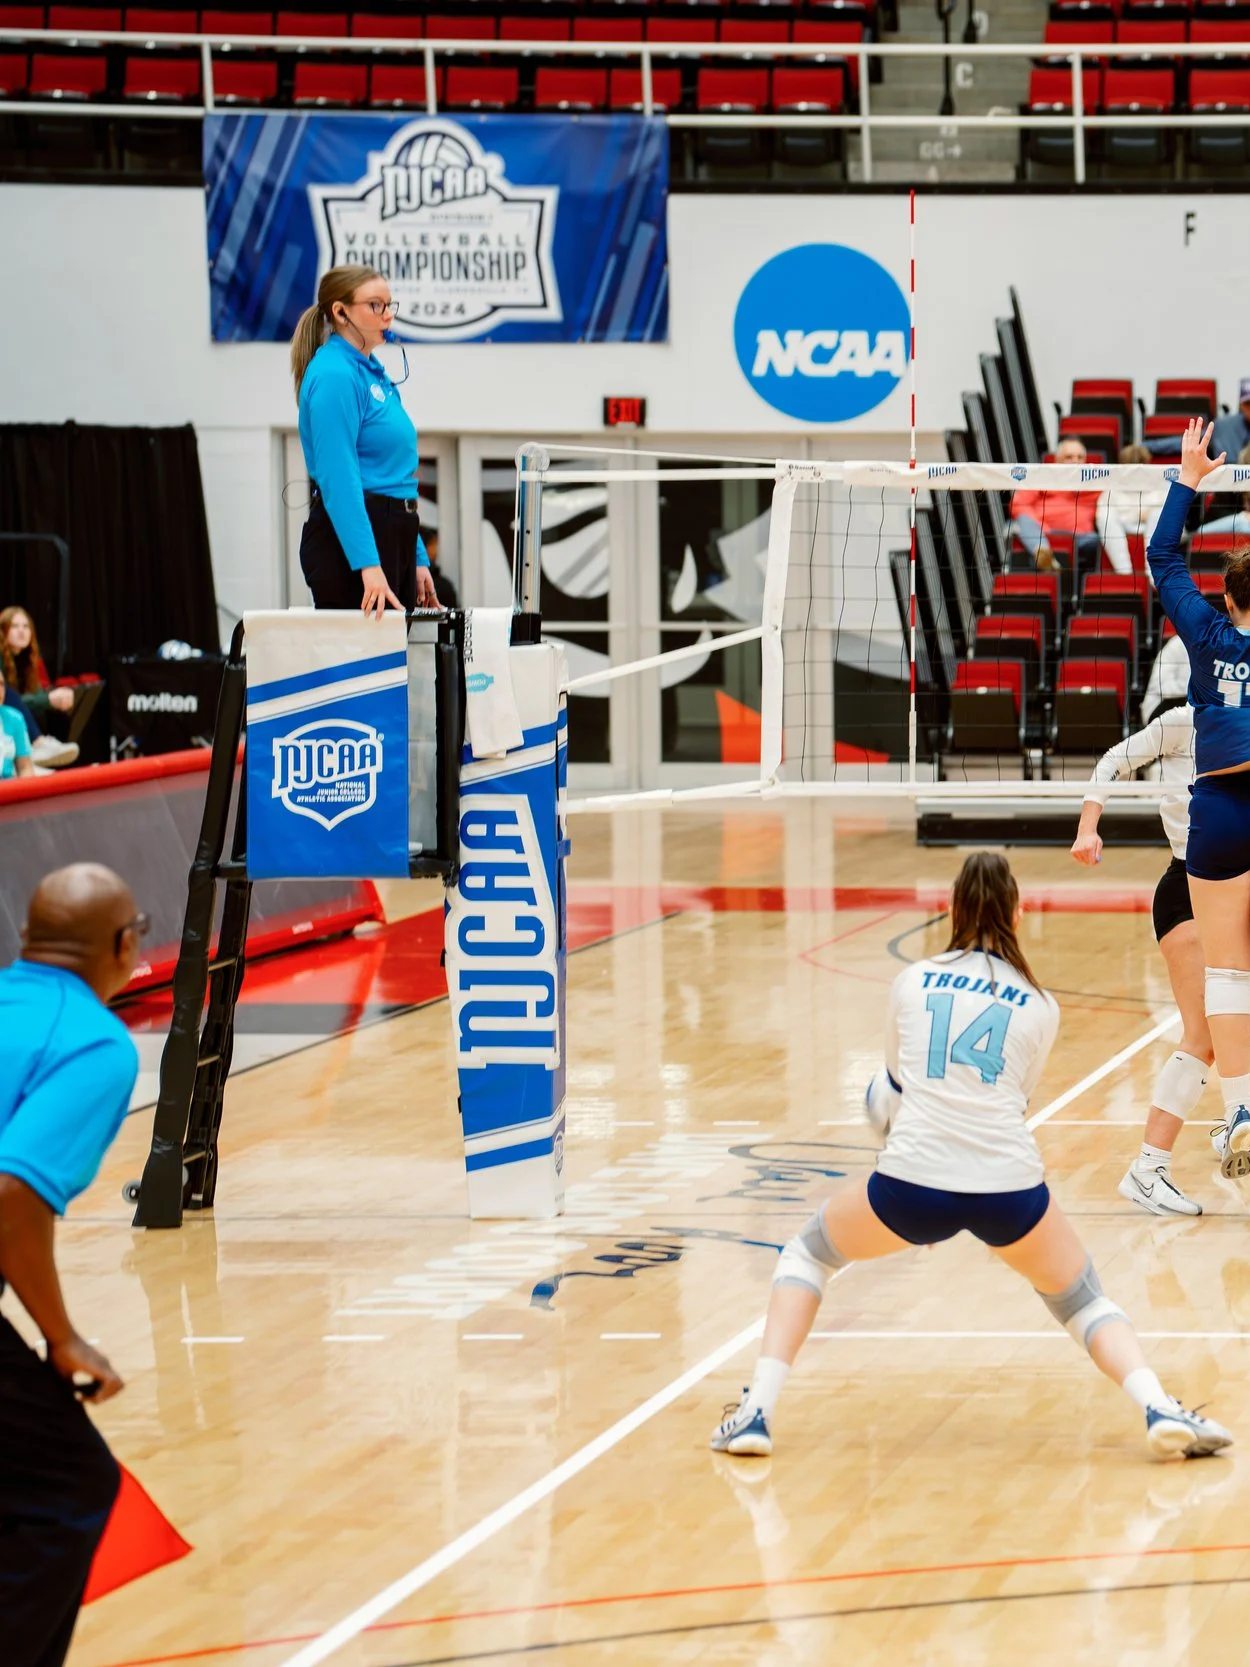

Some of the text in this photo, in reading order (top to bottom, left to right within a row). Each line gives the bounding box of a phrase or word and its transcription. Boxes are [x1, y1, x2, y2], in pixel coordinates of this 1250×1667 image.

[381, 165, 488, 221] NJCAA
[345, 233, 526, 246] VOLLEYBALL
[1184, 211, 1197, 247] F
[409, 303, 467, 316] 2024
[752, 329, 906, 378] NCAA
[928, 466, 957, 479] NJCAA
[1081, 468, 1110, 481] NJCAA
[127, 692, 198, 713] molten
[274, 740, 380, 793] NJCAA
[335, 781, 366, 789] NATIONAL
[457, 806, 557, 1057] NJCAA
[922, 971, 1032, 1007] TROJANS
[926, 993, 1013, 1086] 14
